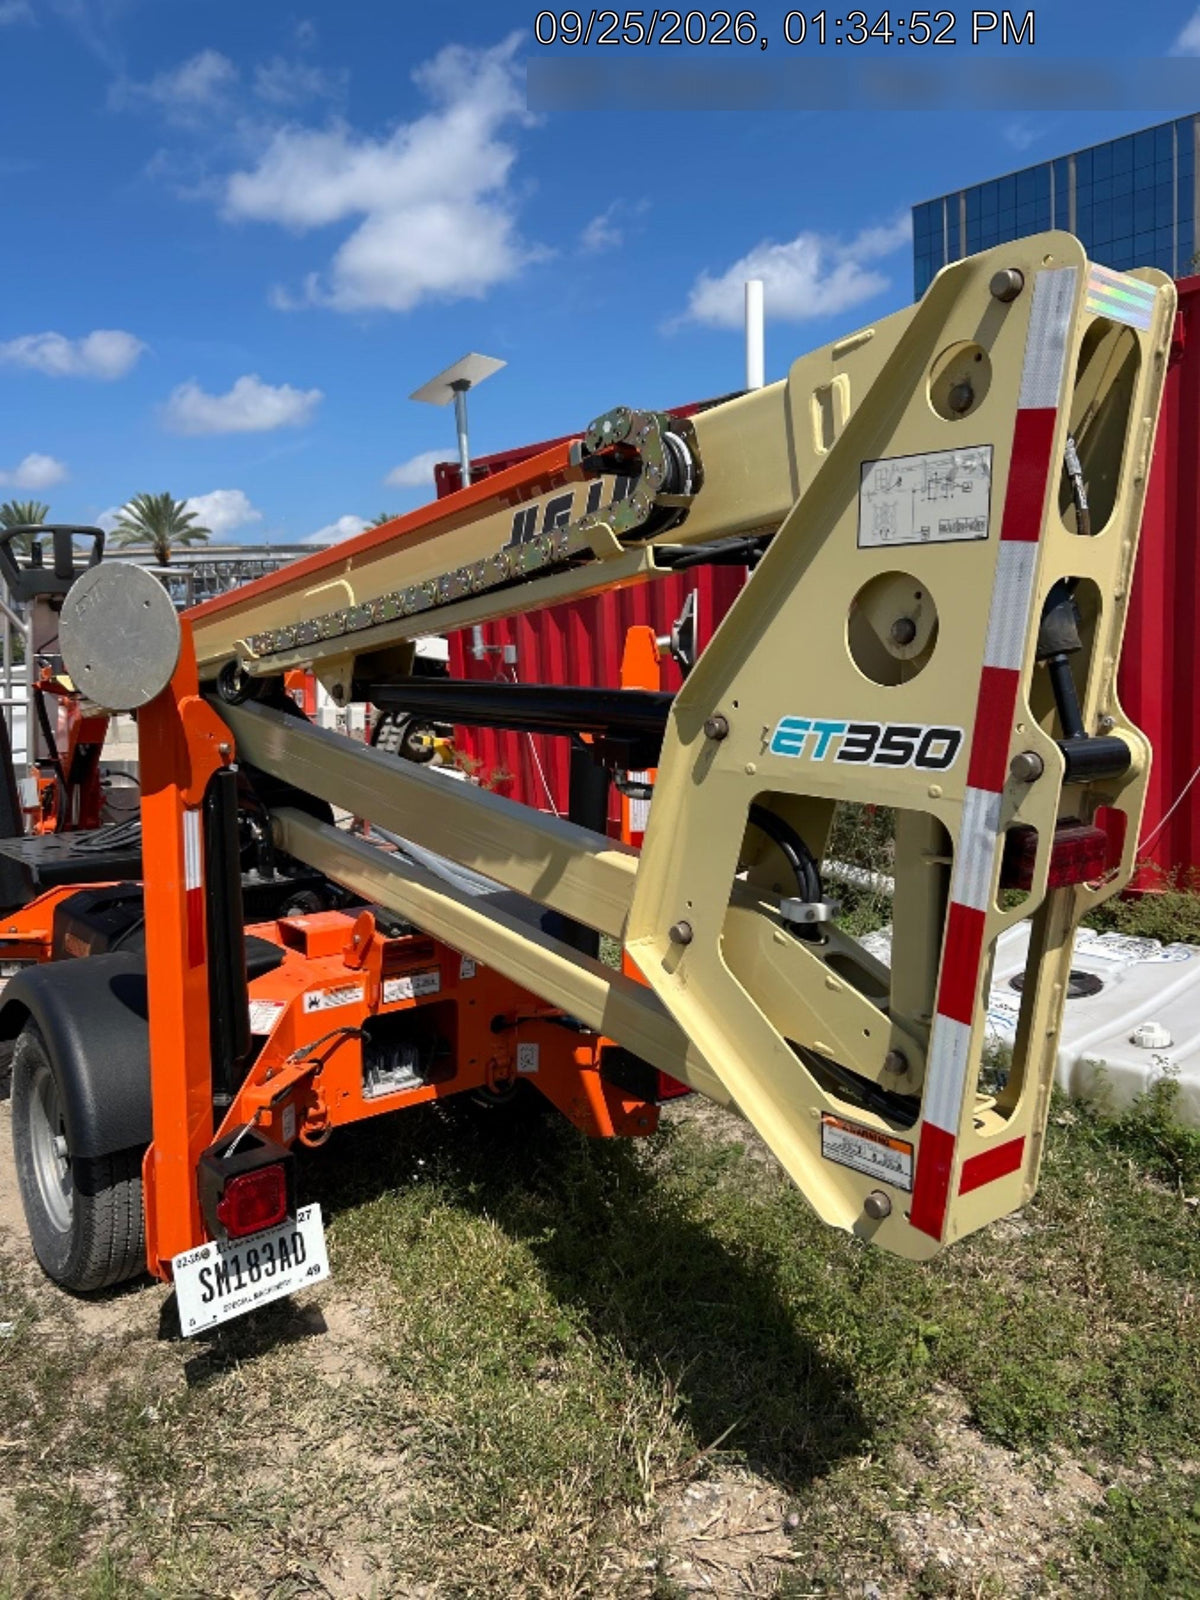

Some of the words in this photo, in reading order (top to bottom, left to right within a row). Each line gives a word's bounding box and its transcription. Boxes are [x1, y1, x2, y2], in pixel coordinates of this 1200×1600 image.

[770, 715, 964, 772] ET350
[297, 1209, 312, 1223] 27
[198, 1231, 307, 1304] SM183AD
[305, 1263, 321, 1277] 49
